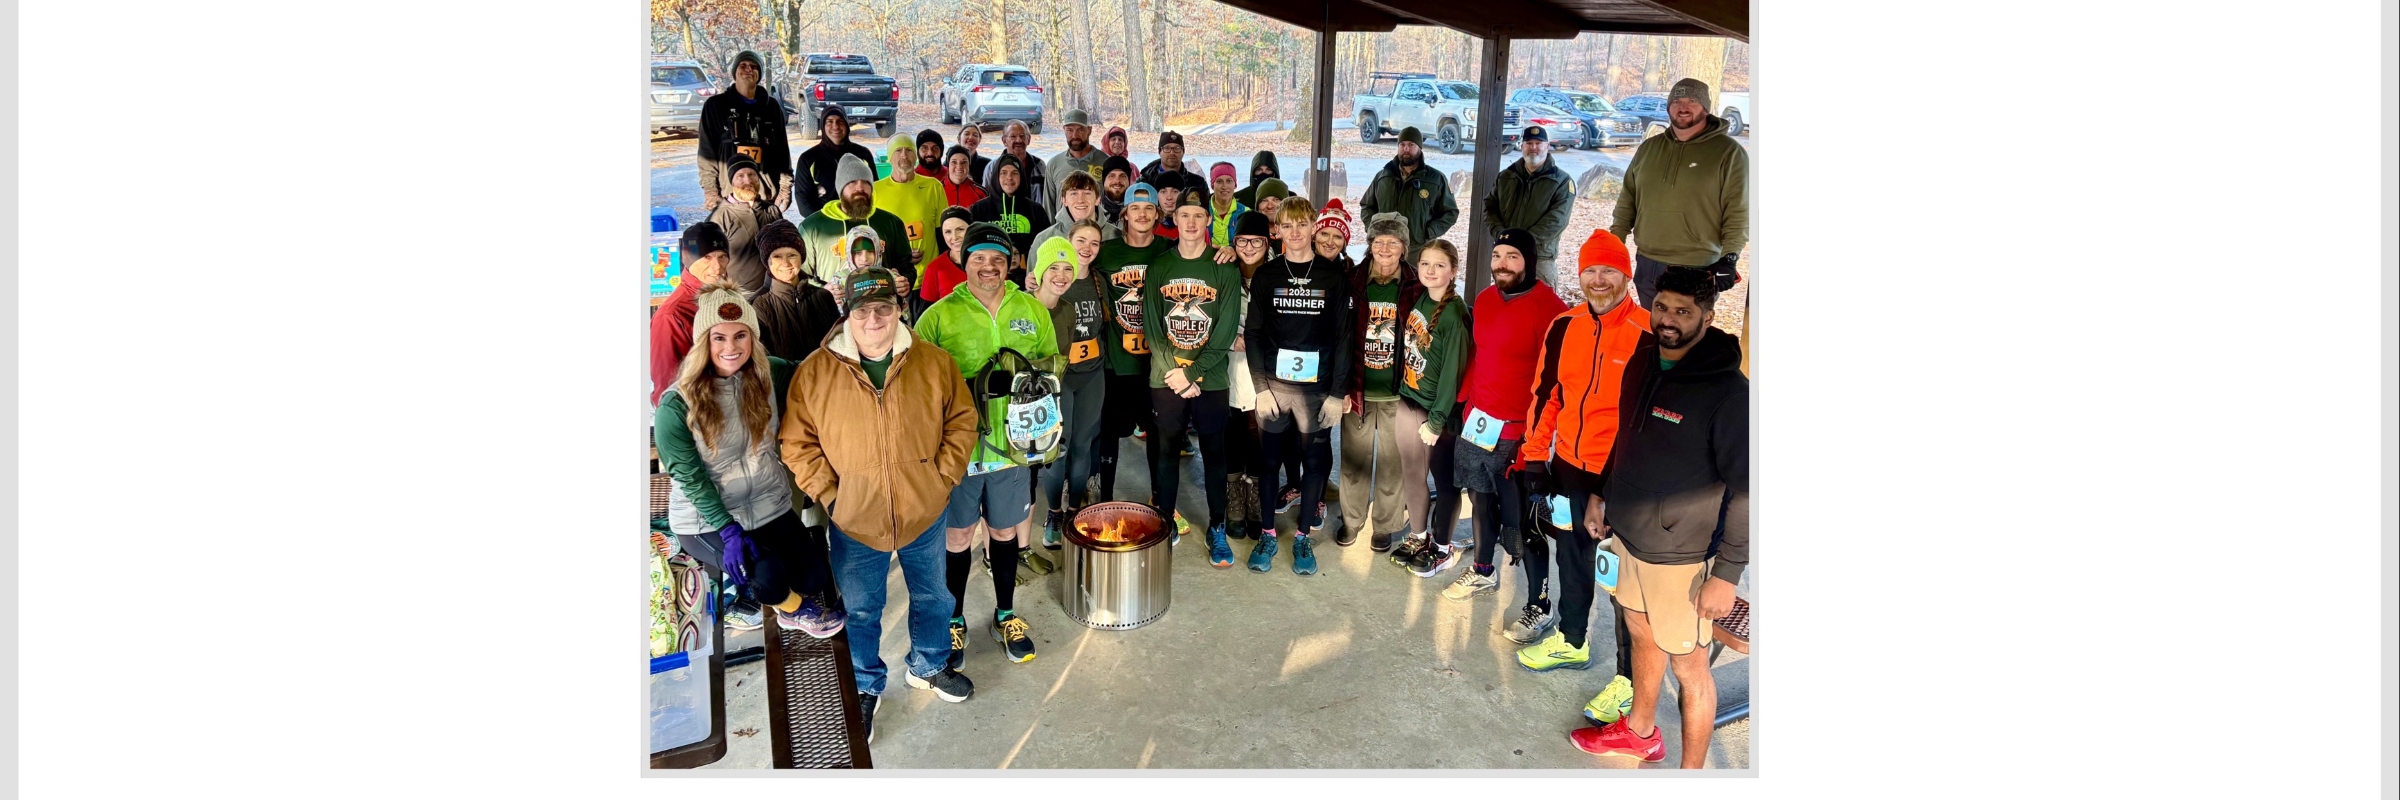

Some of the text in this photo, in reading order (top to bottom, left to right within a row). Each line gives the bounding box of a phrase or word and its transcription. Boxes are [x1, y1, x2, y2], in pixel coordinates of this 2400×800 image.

[1191, 284, 1217, 300] RACE
[1289, 288, 1311, 297] 2023
[1273, 298, 1325, 309] FINISHER
[1171, 320, 1204, 331] TRIPLE C
[1079, 344, 1089, 359] 3
[1131, 337, 1150, 351] 10
[1291, 356, 1304, 372] 3
[1018, 405, 1048, 430] 50
[1475, 416, 1488, 435] 9
[1596, 554, 1610, 576] 0
